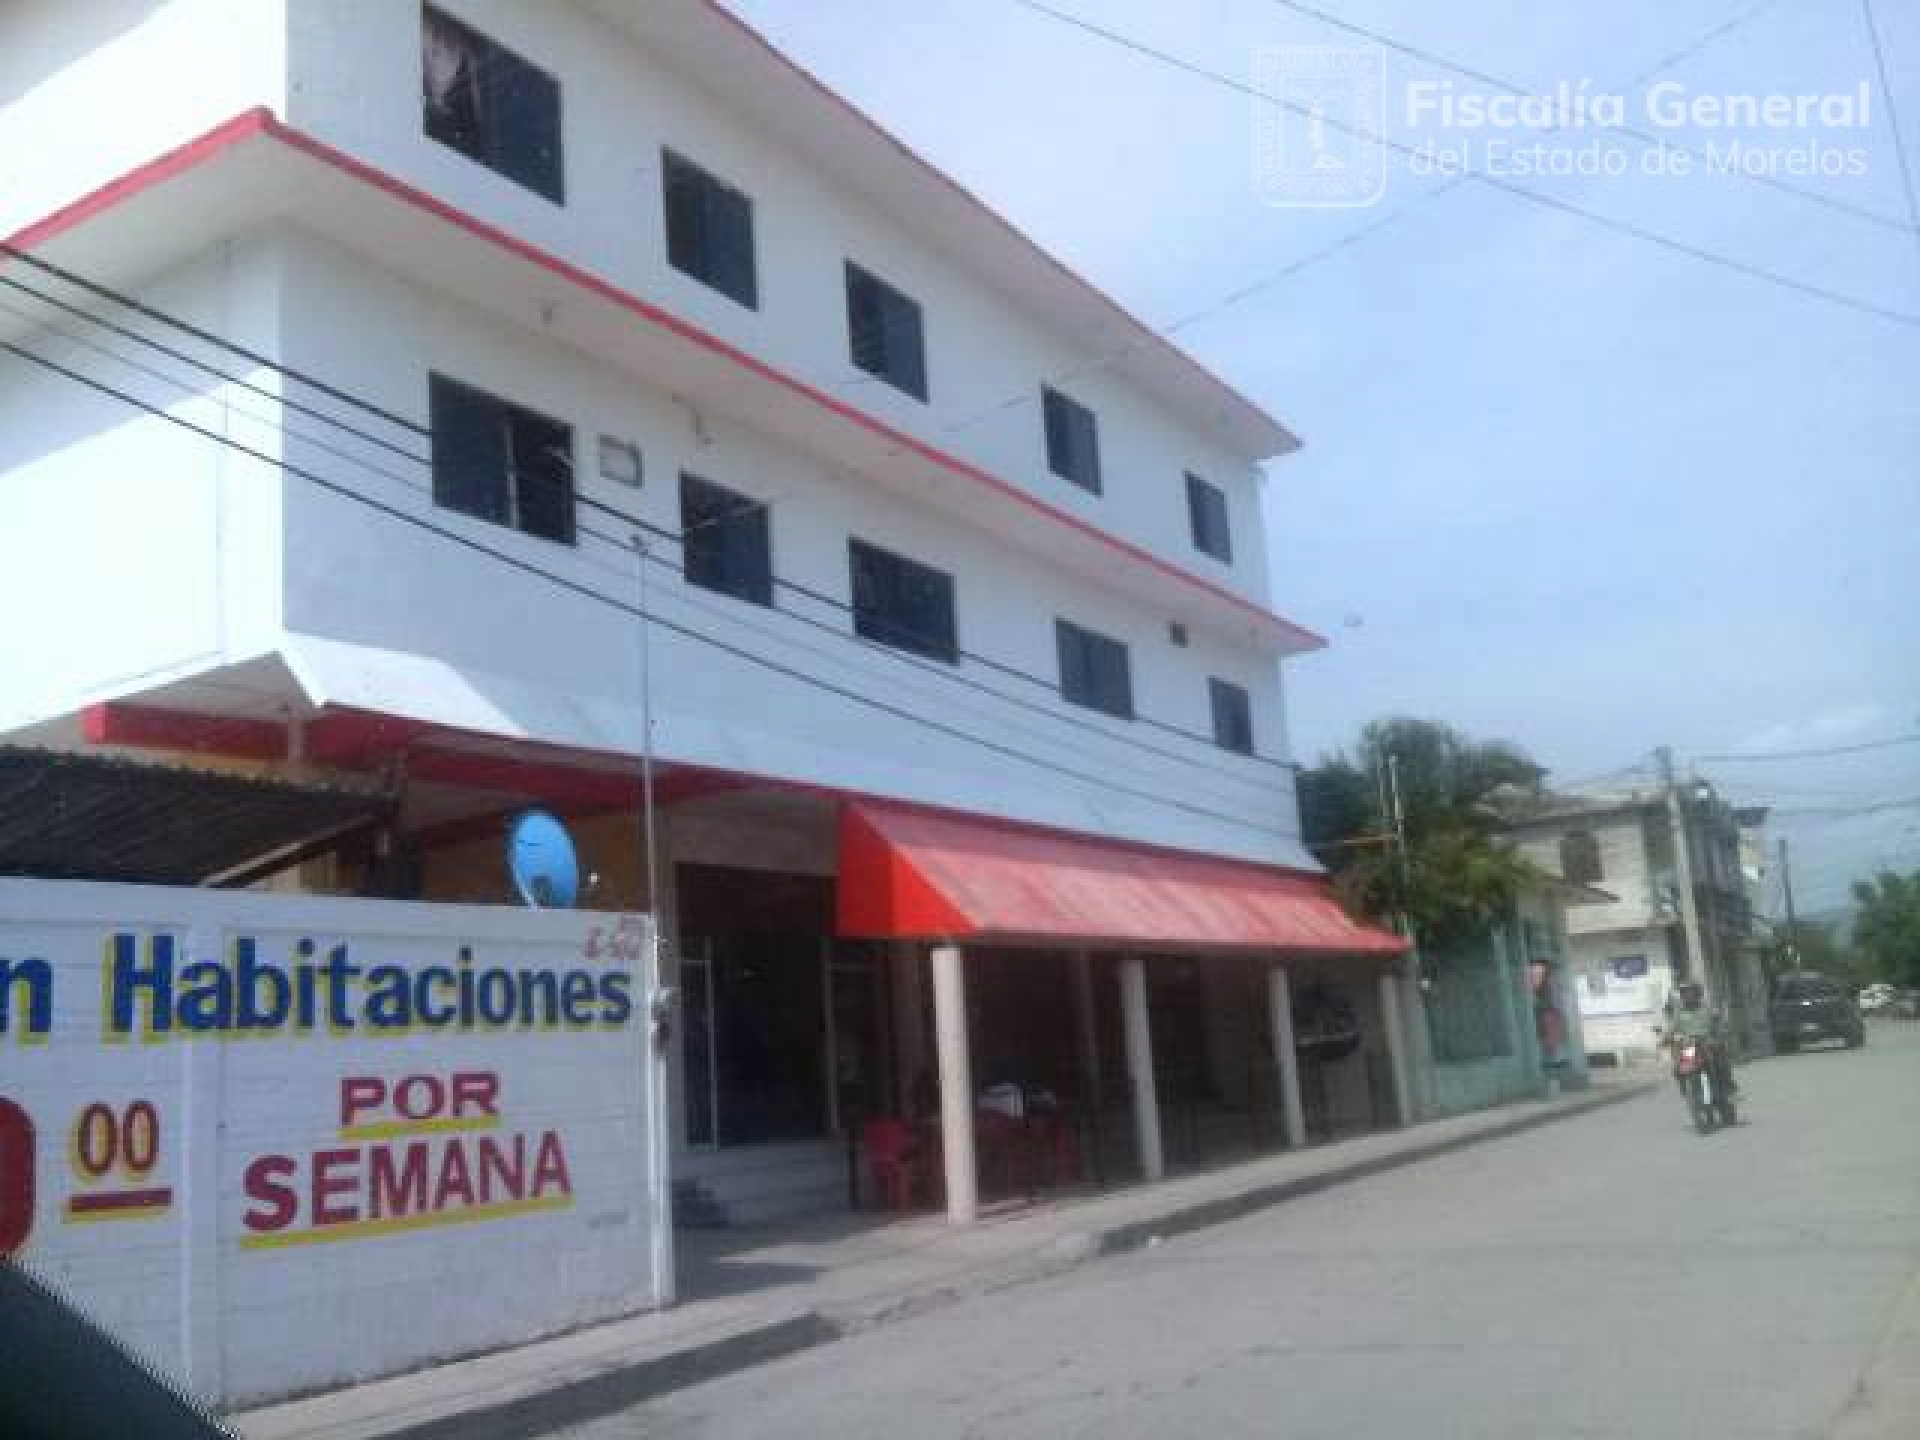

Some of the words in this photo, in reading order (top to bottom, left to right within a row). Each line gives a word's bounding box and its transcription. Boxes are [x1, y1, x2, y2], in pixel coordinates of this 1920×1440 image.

[104, 933, 631, 1042] Habitaciones
[73, 1100, 161, 1178] 00
[340, 1071, 501, 1126] POR
[242, 1130, 572, 1231] SEMANA
